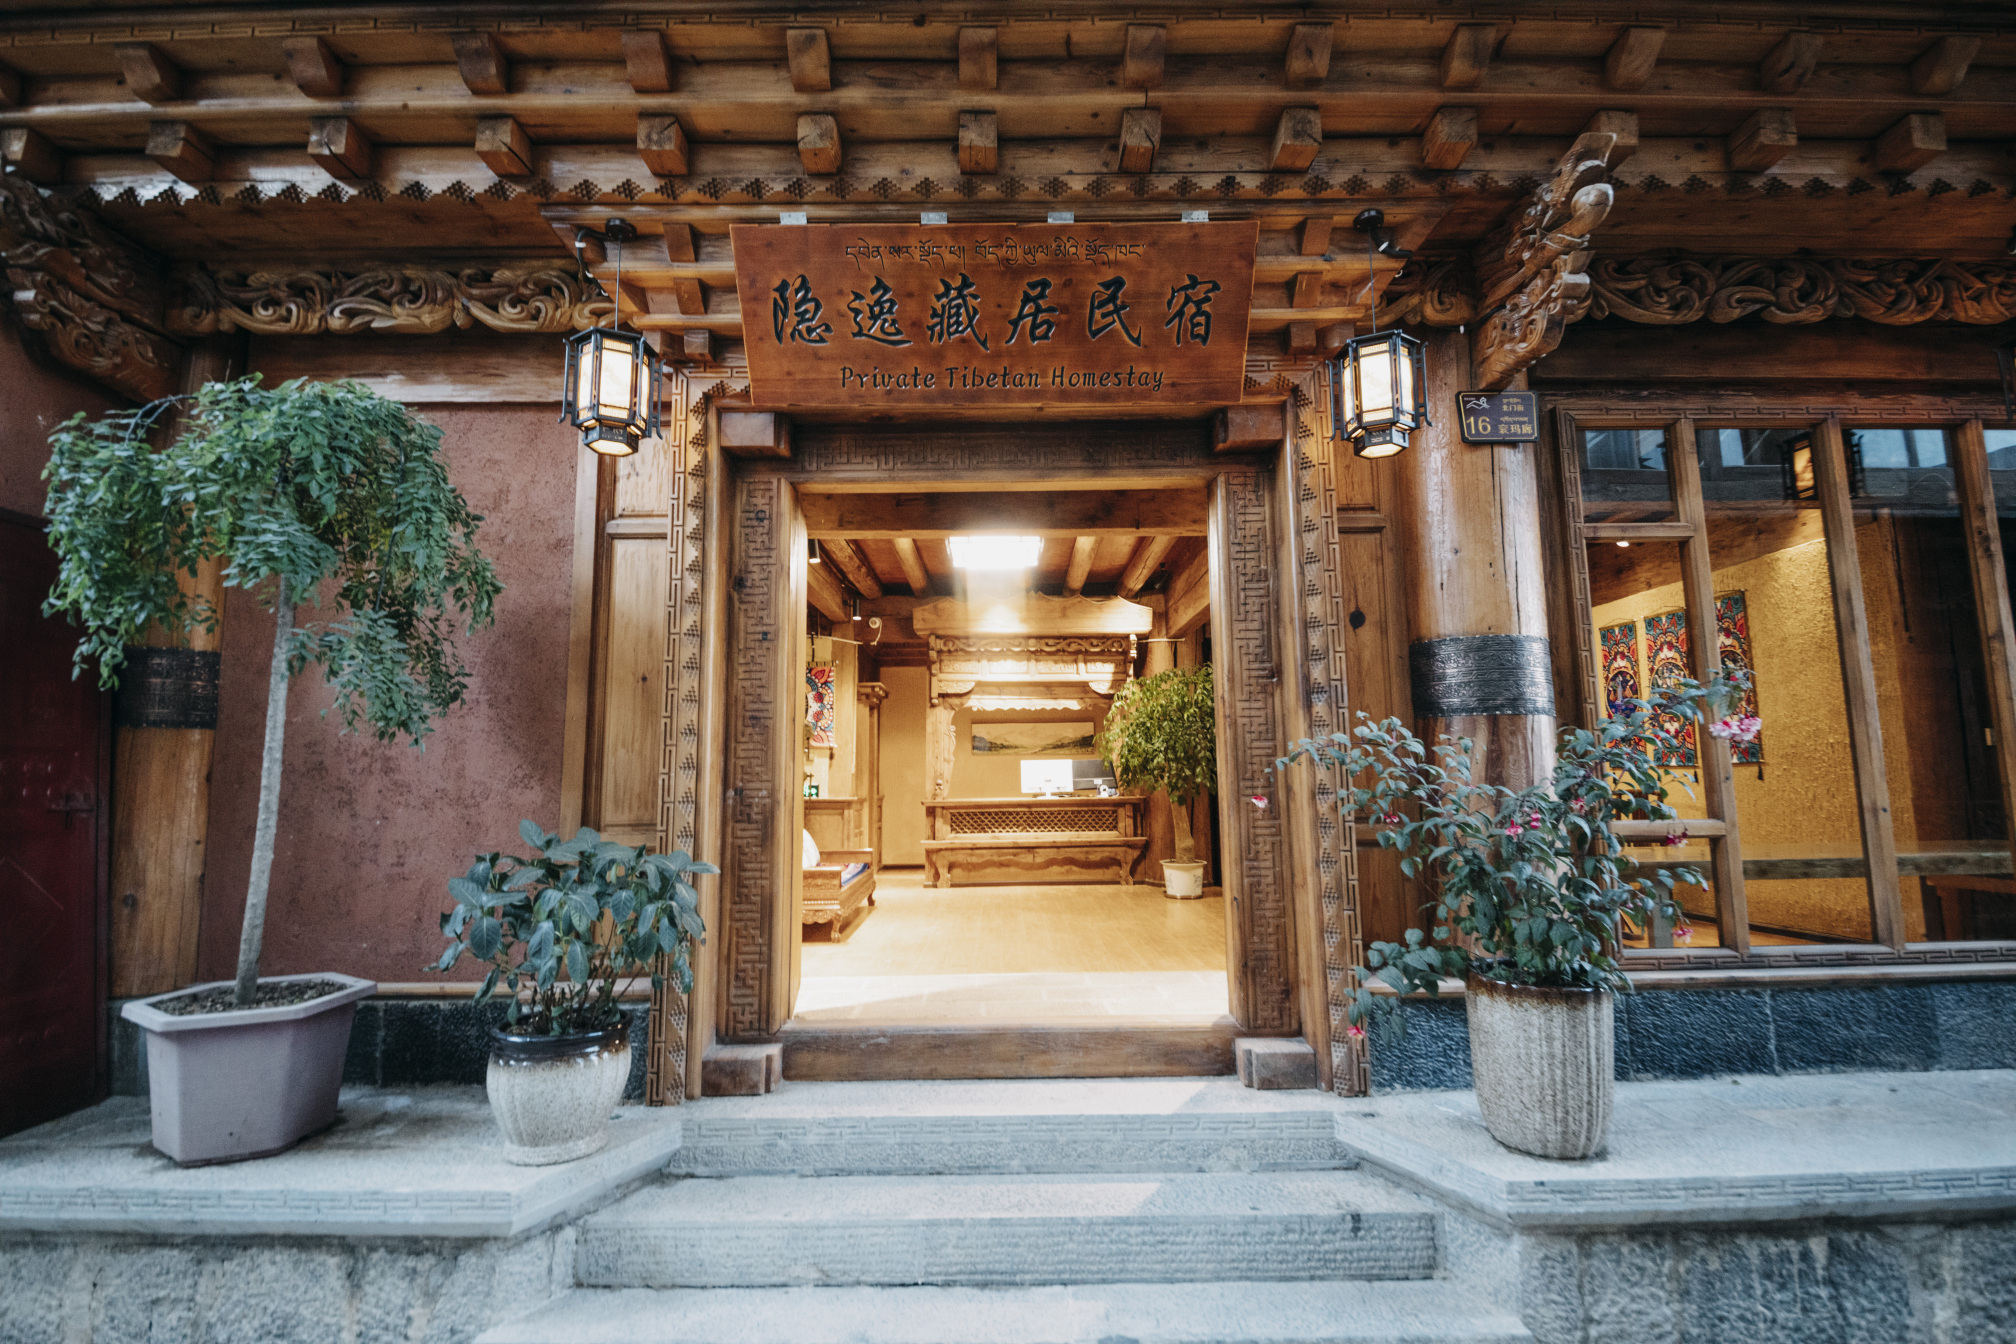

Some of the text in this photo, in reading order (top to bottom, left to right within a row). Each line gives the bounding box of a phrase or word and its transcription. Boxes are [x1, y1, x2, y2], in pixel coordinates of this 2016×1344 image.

[772, 273, 1222, 351] 隐逸藏居民宿
[840, 366, 1165, 391] Private Tibetan Homestay
[1466, 416, 1491, 434] 16
